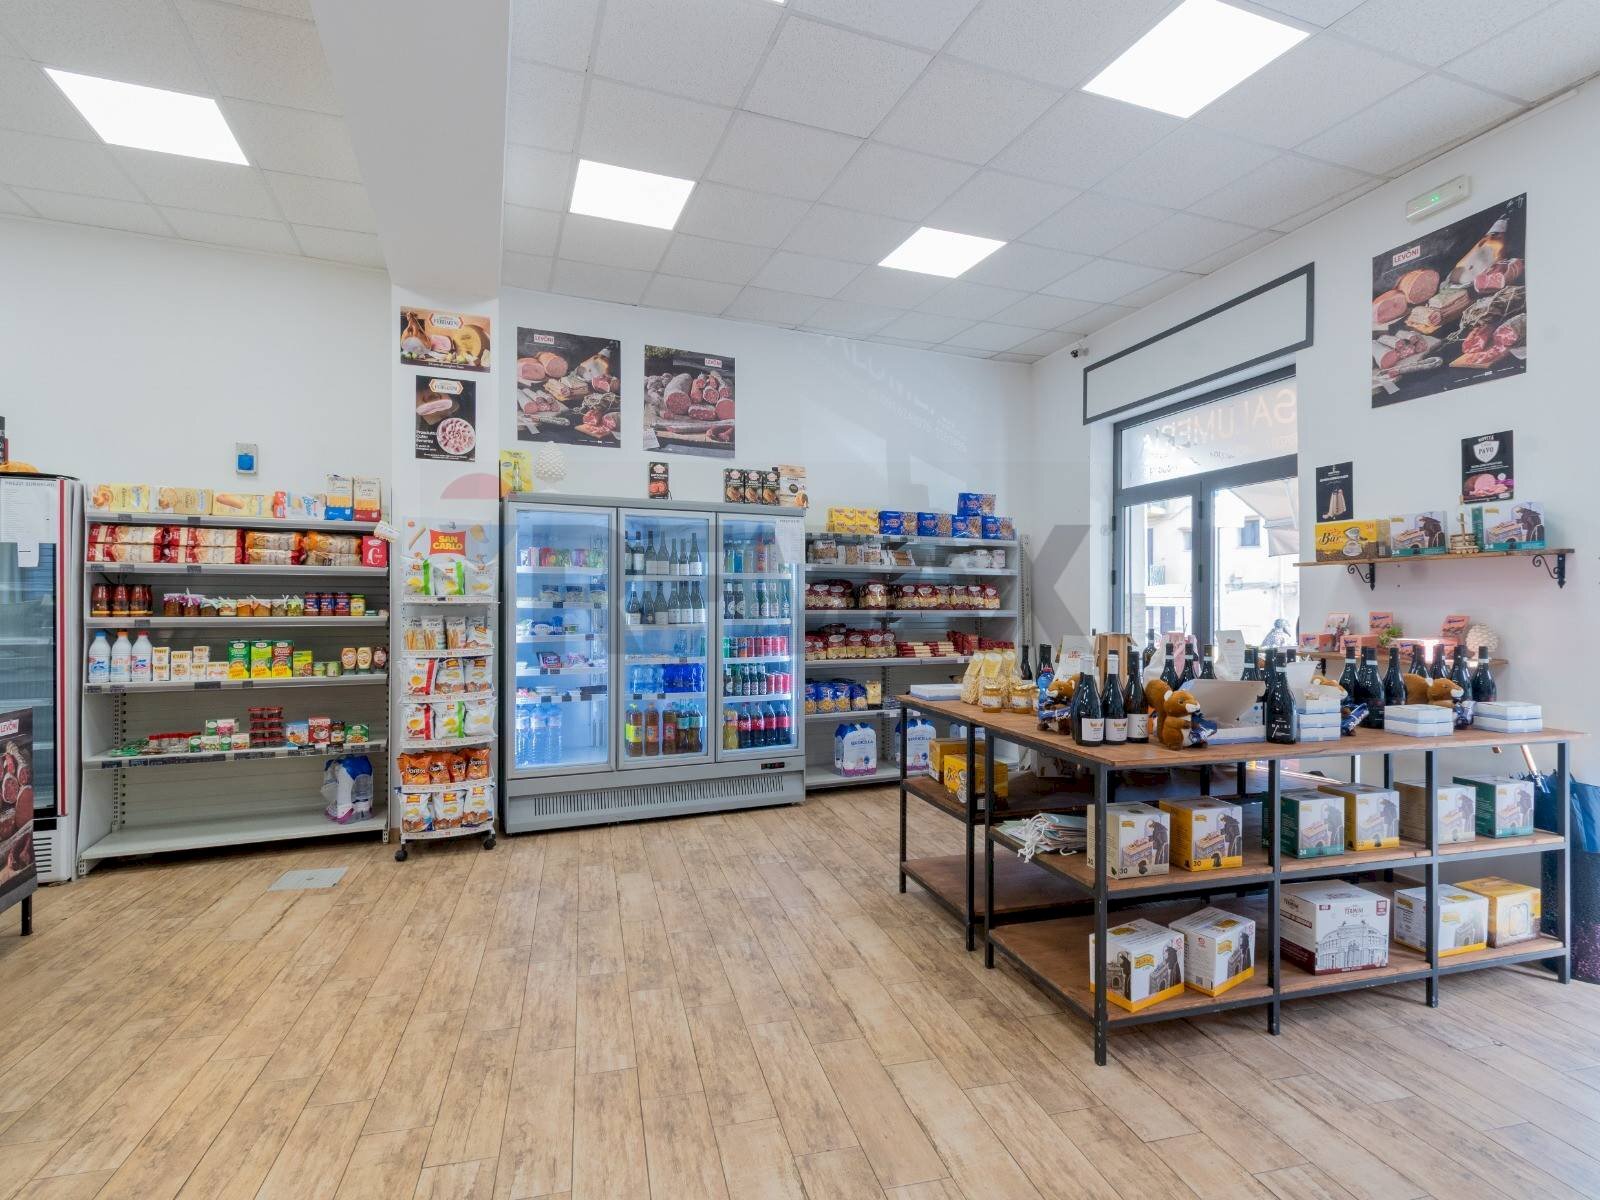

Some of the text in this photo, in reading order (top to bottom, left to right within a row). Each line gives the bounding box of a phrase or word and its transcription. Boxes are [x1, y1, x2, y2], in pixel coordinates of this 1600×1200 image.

[1393, 247, 1420, 264] LEVONI
[438, 535, 458, 543] SAN
[432, 542, 463, 550] CARLO
